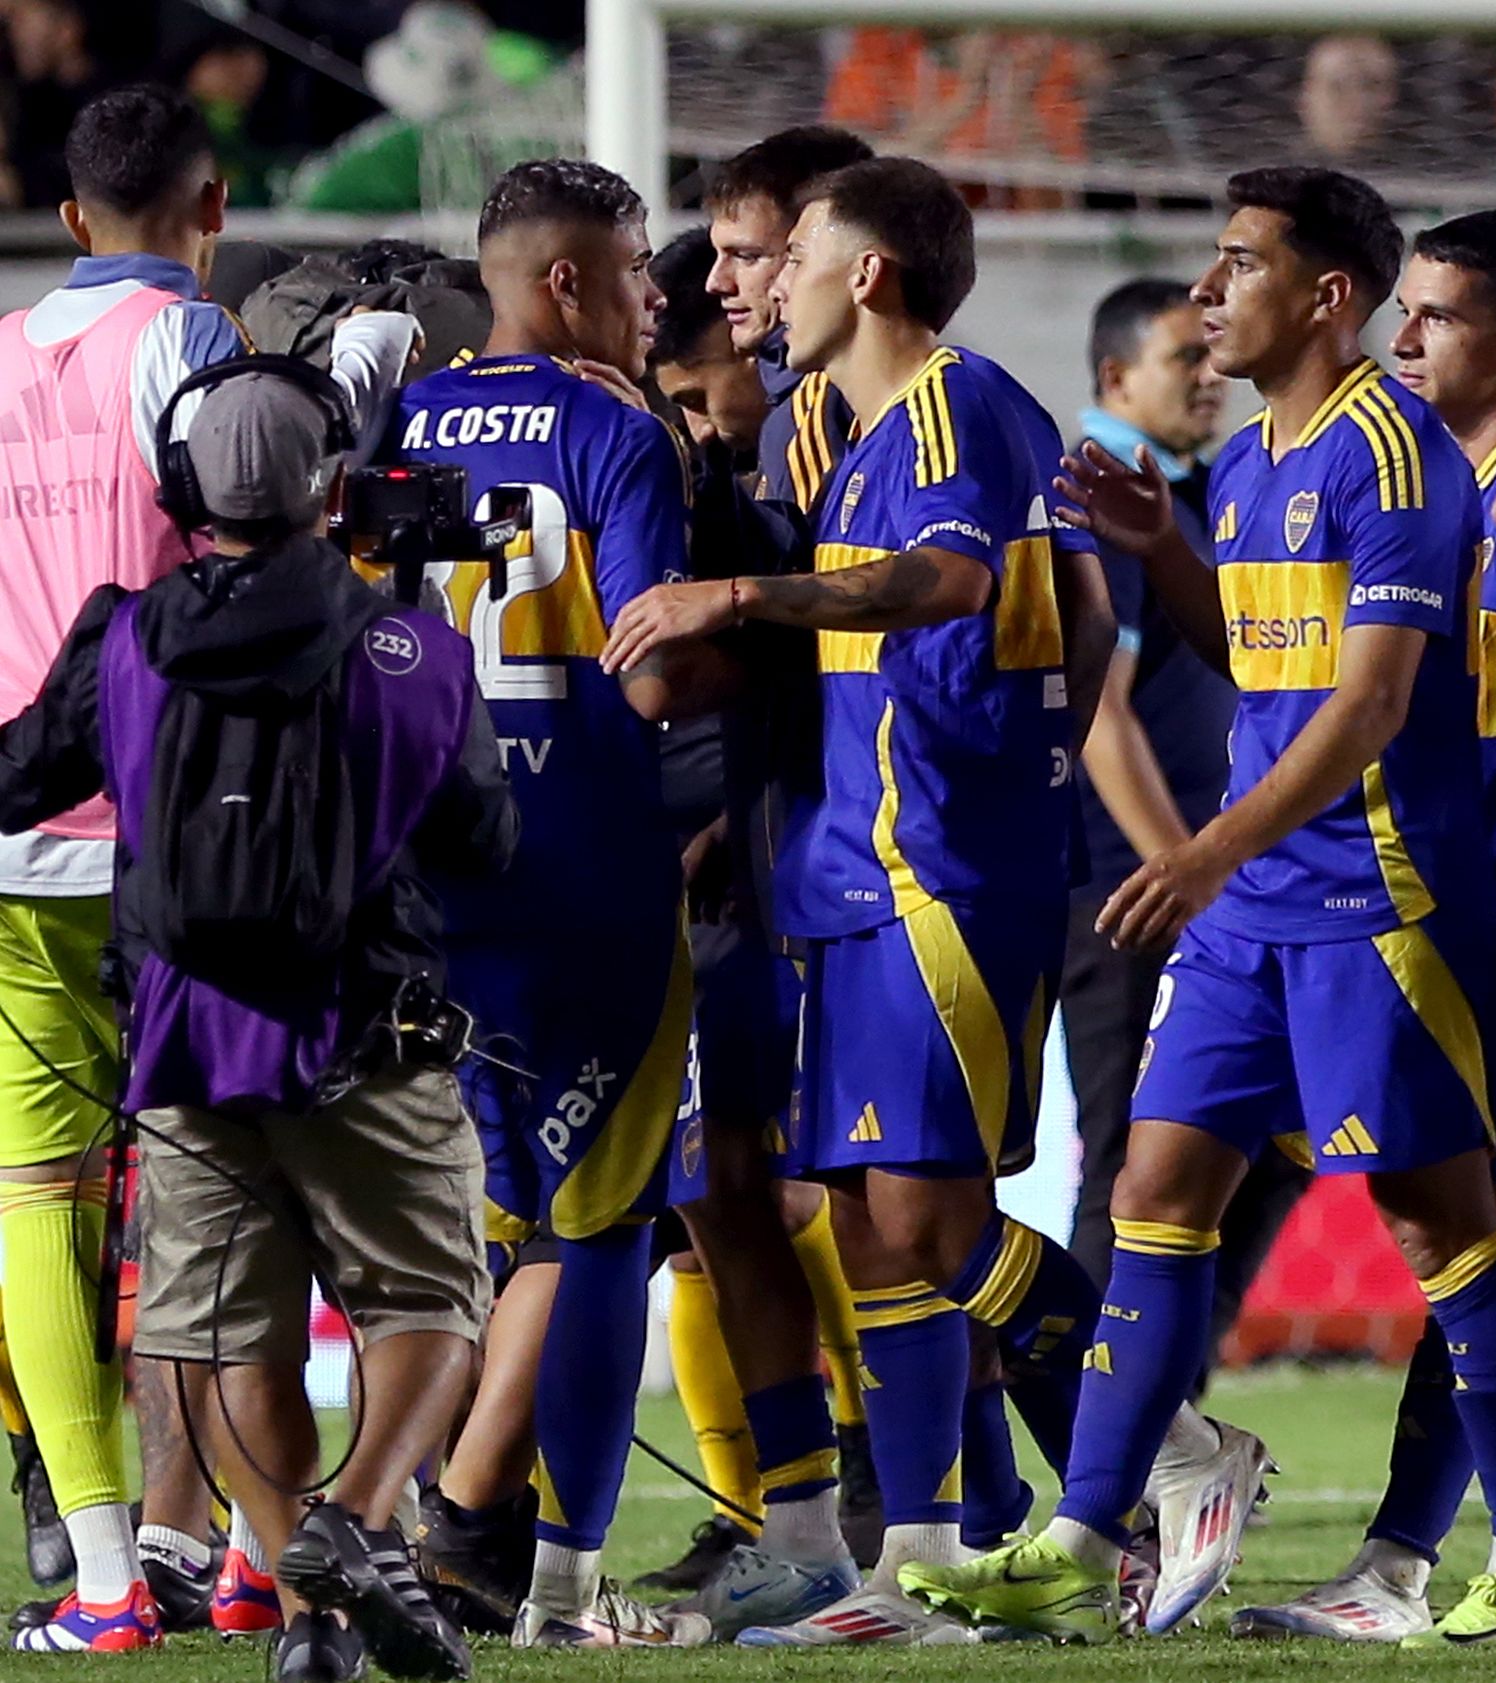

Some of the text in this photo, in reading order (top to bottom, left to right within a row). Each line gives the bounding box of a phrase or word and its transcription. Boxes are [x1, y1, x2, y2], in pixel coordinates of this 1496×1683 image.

[401, 405, 556, 449] A.COSTA
[1367, 585, 1443, 610] CETROGAR
[372, 631, 413, 659] 232
[537, 1057, 617, 1166] pax
